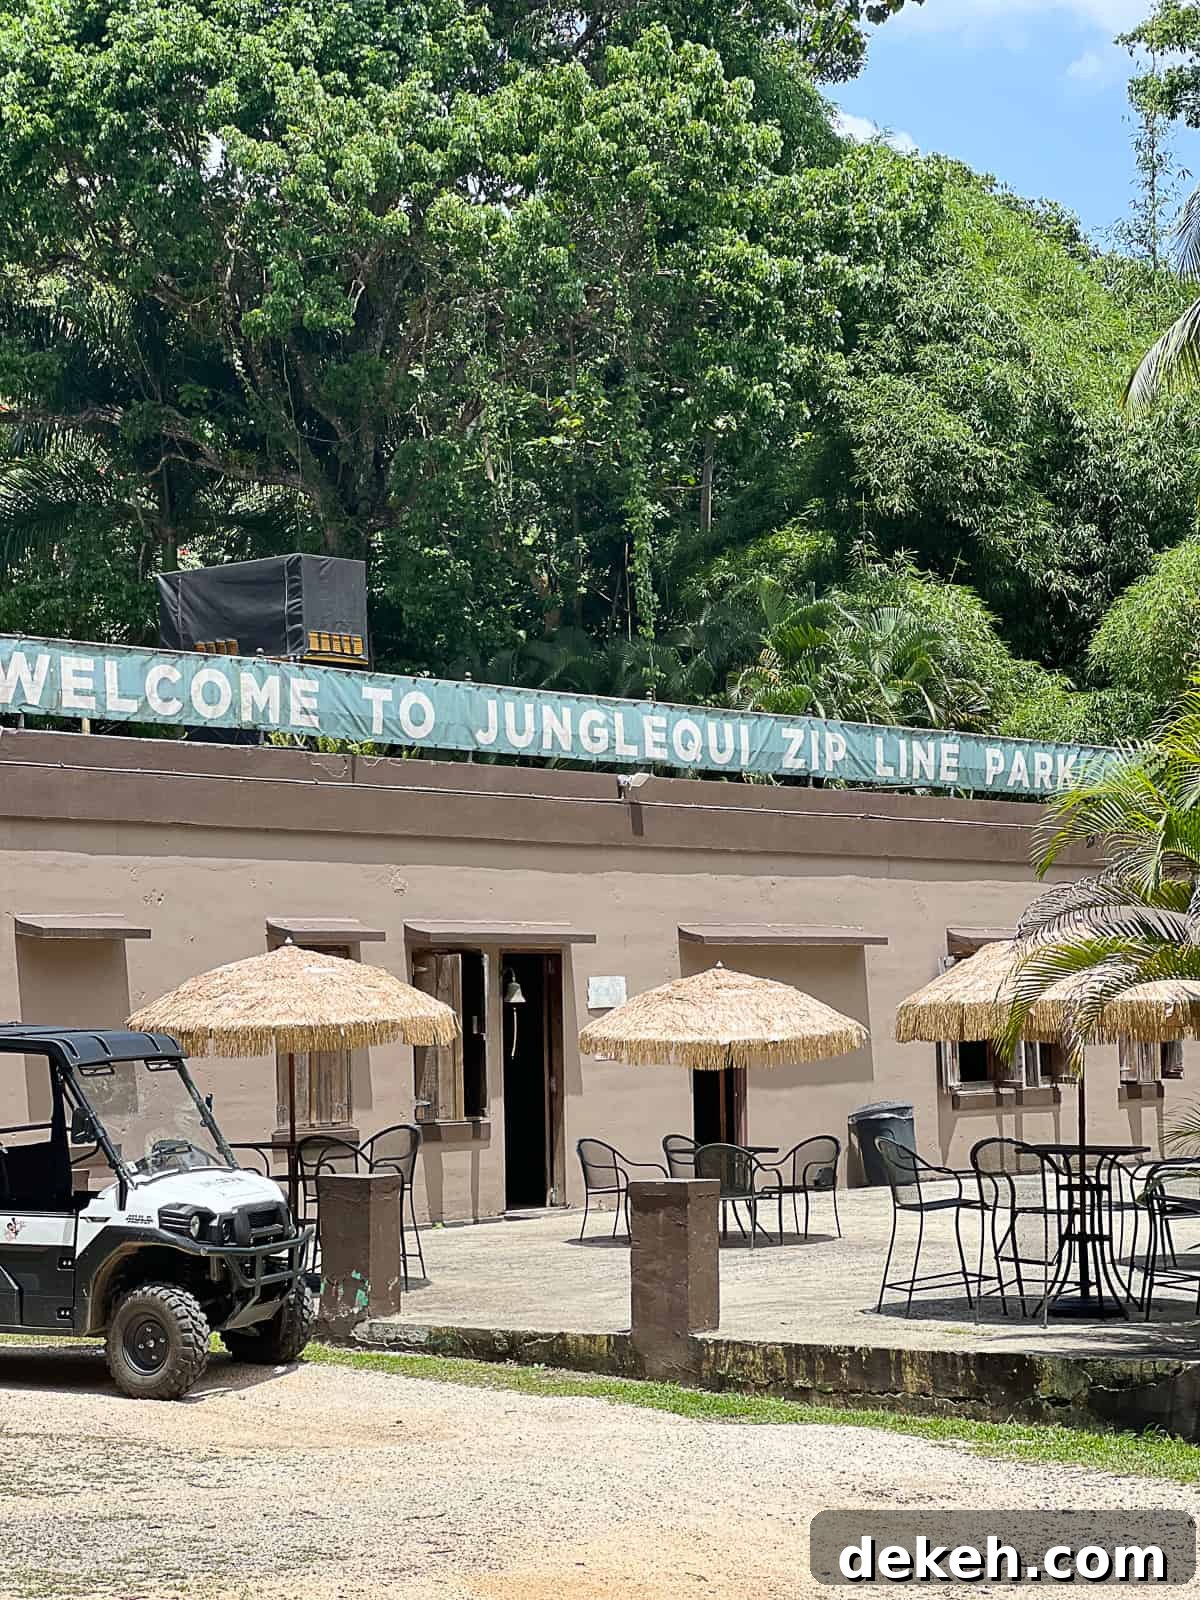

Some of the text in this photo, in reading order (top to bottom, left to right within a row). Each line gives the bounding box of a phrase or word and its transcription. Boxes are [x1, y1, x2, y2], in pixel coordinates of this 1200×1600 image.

[0, 651, 1077, 791] WELCOME TO JUNGLEQUI ZIP LINE PARK
